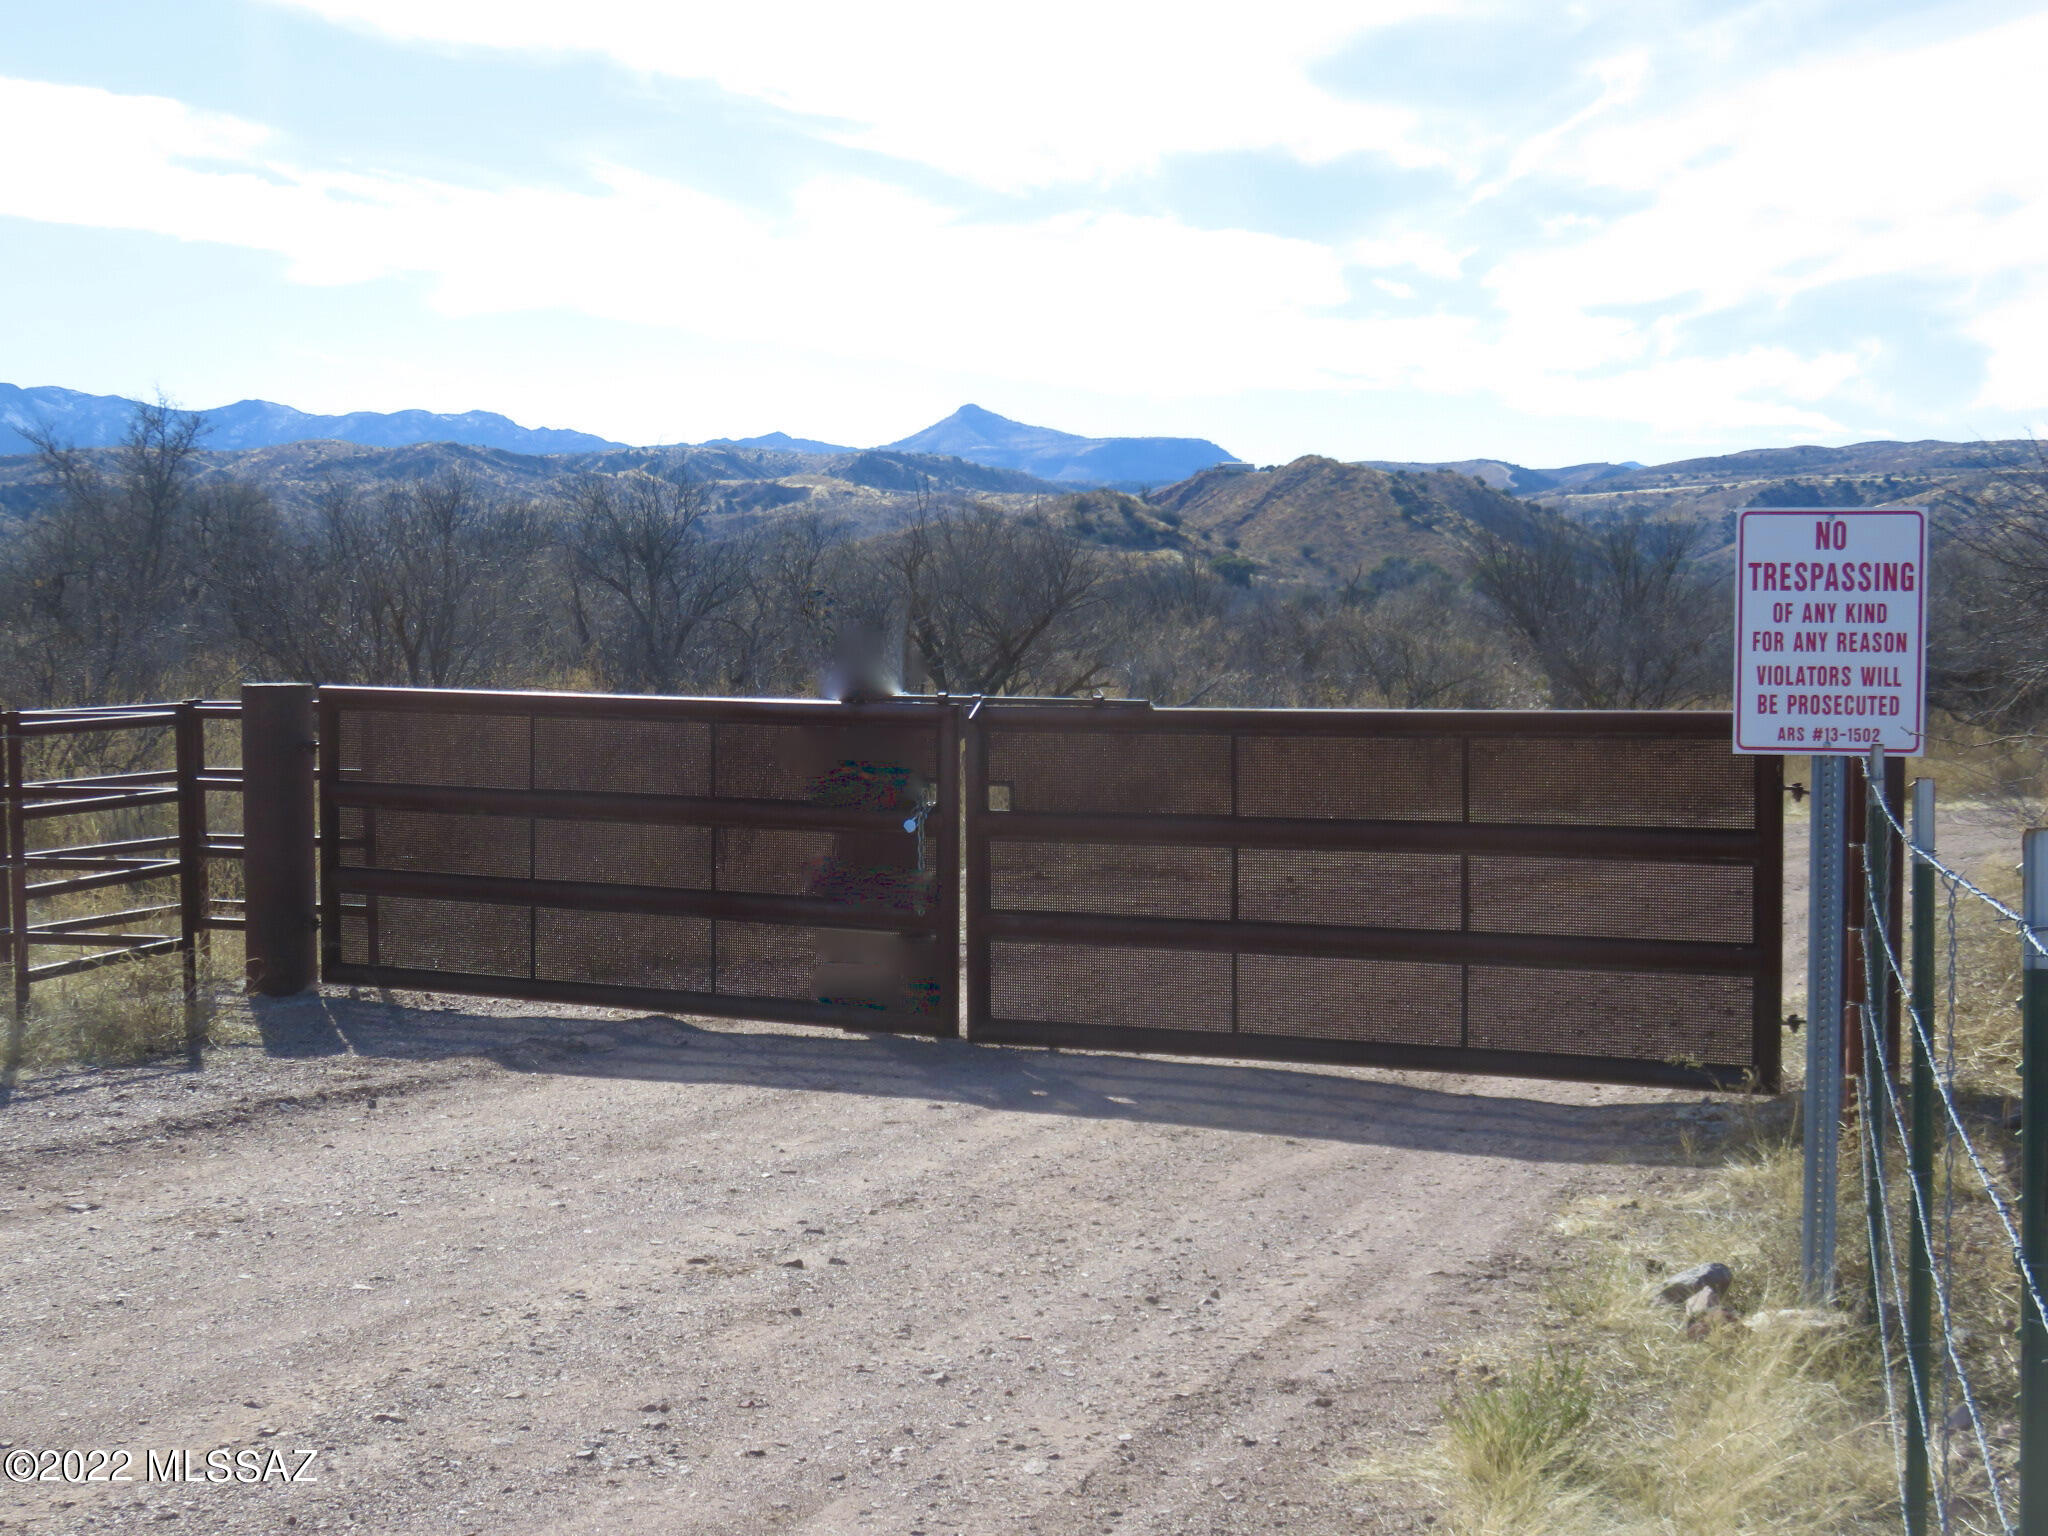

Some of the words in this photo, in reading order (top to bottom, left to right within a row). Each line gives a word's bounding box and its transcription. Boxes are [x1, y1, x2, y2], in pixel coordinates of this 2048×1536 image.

[1815, 520, 1847, 550] NO
[1748, 562, 1915, 592] TRESPASSING
[1773, 603, 1793, 623] OF
[1802, 603, 1836, 623] ANY
[1845, 603, 1887, 623] KIND
[1752, 631, 1784, 652] FOR
[1793, 632, 1828, 652] ANY
[1836, 632, 1908, 653] REASON
[1756, 665, 1851, 686] VIOLATORS
[1861, 666, 1902, 687] WILL
[1757, 694, 1777, 715] BE
[1787, 694, 1900, 716] PROSECUTED
[1777, 727, 1804, 741] ARS
[1812, 728, 1880, 742] #13-1502
